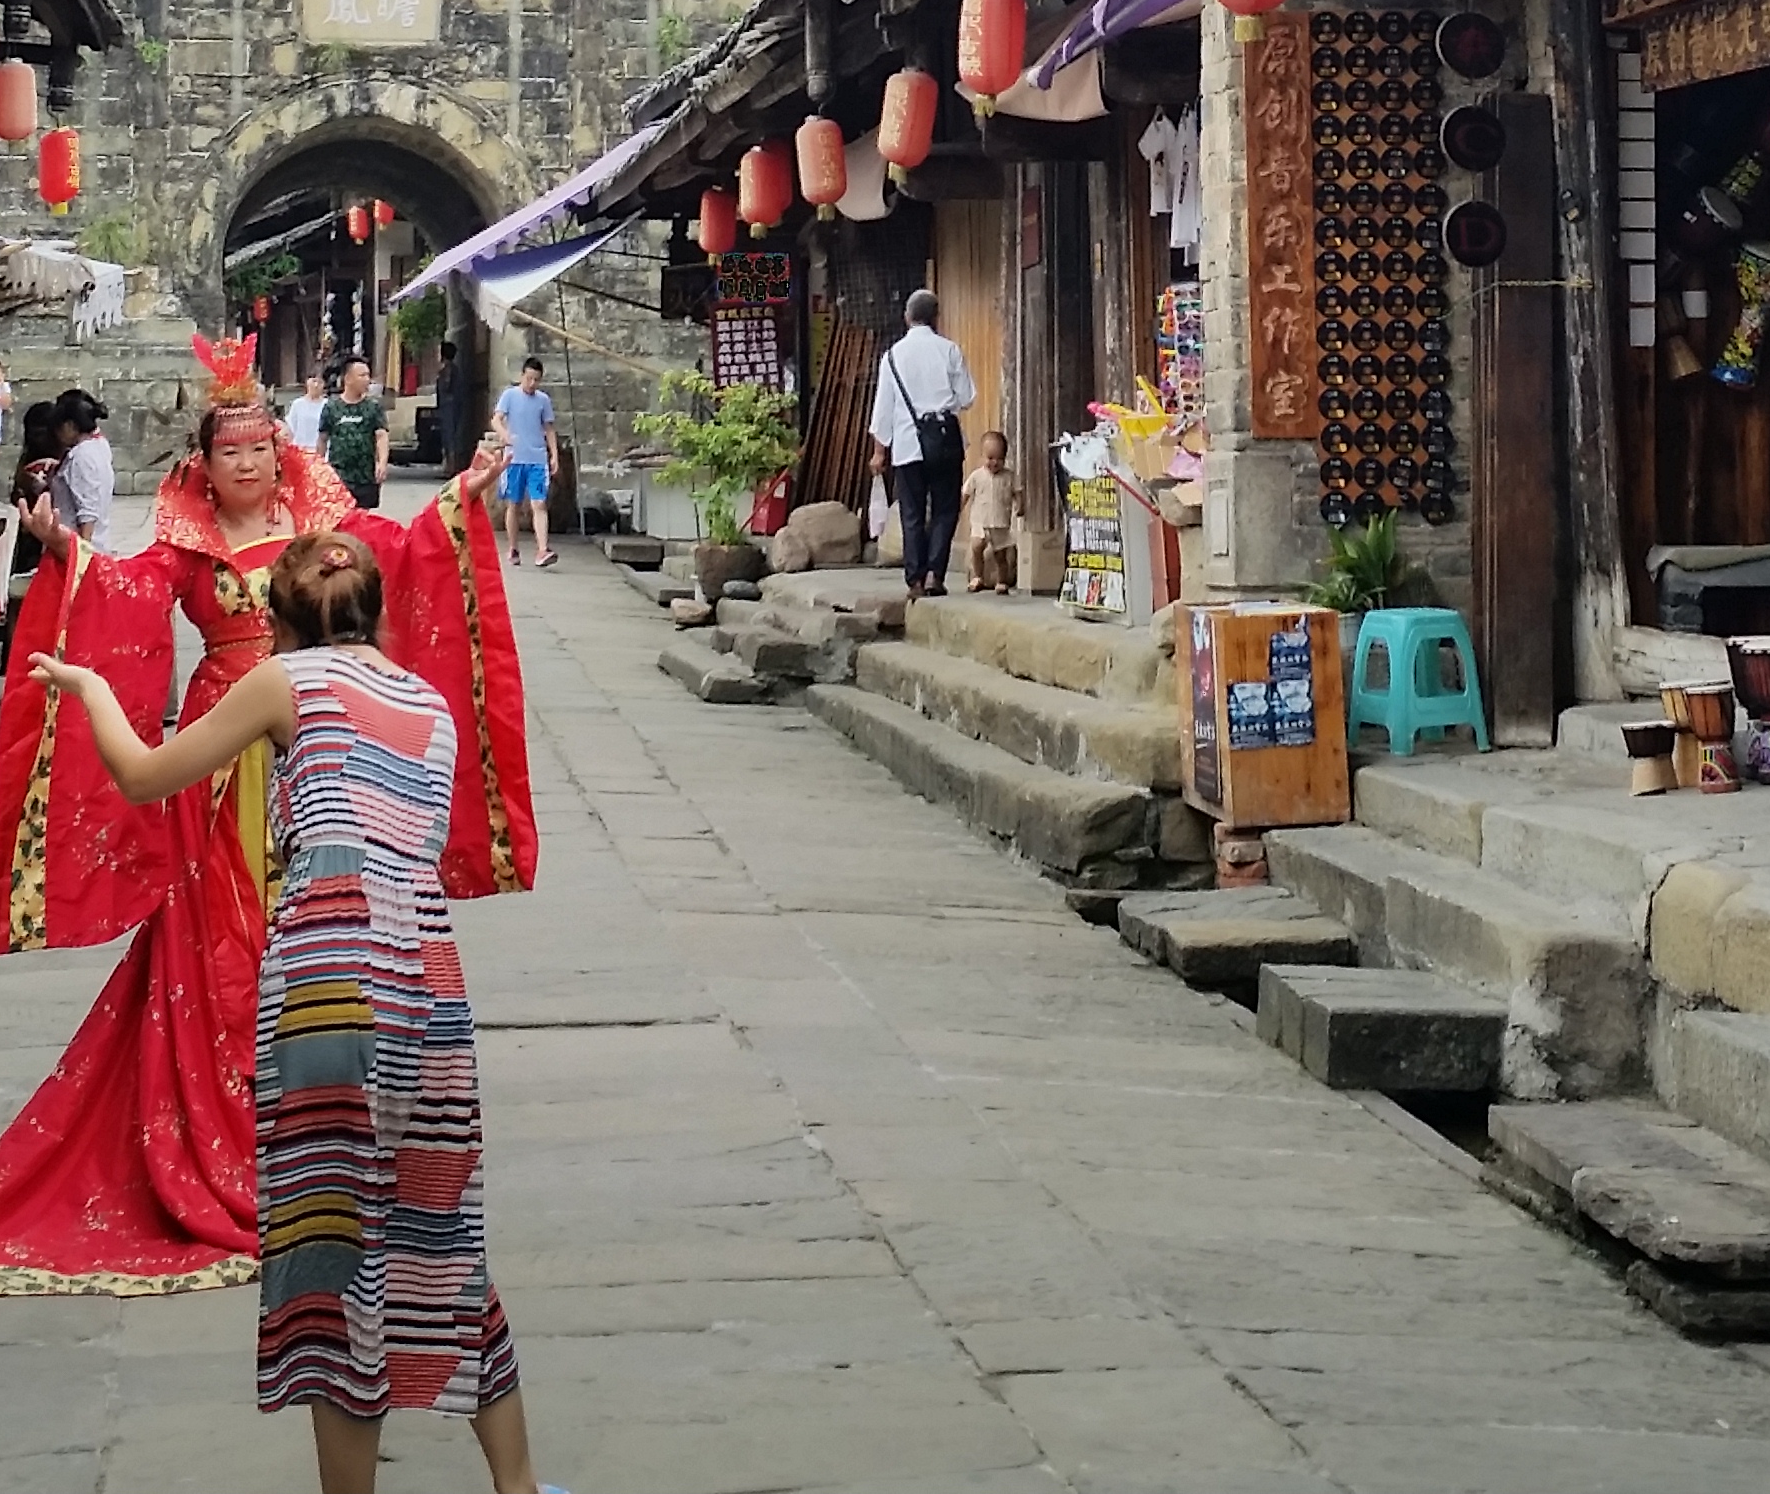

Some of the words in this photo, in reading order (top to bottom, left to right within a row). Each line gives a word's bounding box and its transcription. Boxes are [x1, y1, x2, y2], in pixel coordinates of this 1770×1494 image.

[1256, 22, 1305, 420] 原创音乐工作室
